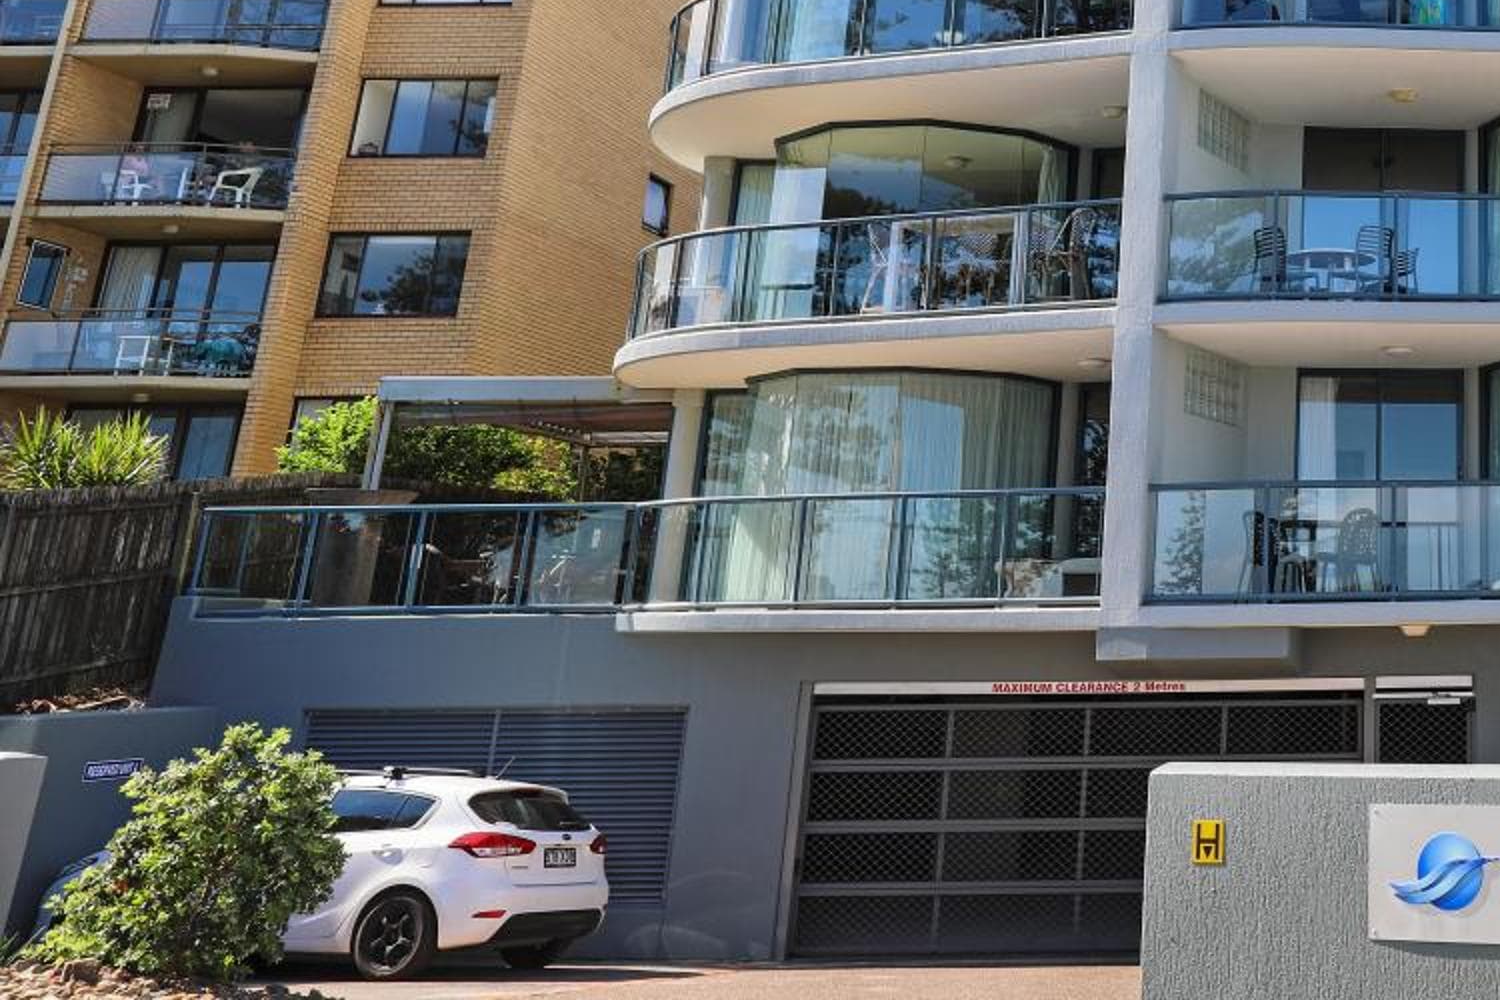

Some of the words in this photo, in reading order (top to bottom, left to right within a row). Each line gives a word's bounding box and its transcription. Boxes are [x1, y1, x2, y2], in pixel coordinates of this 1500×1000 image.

[992, 683, 1052, 693] MAXIMUM
[1055, 683, 1128, 693] CLEARANCE
[1133, 682, 1141, 691] 2
[1145, 682, 1185, 691] Metres
